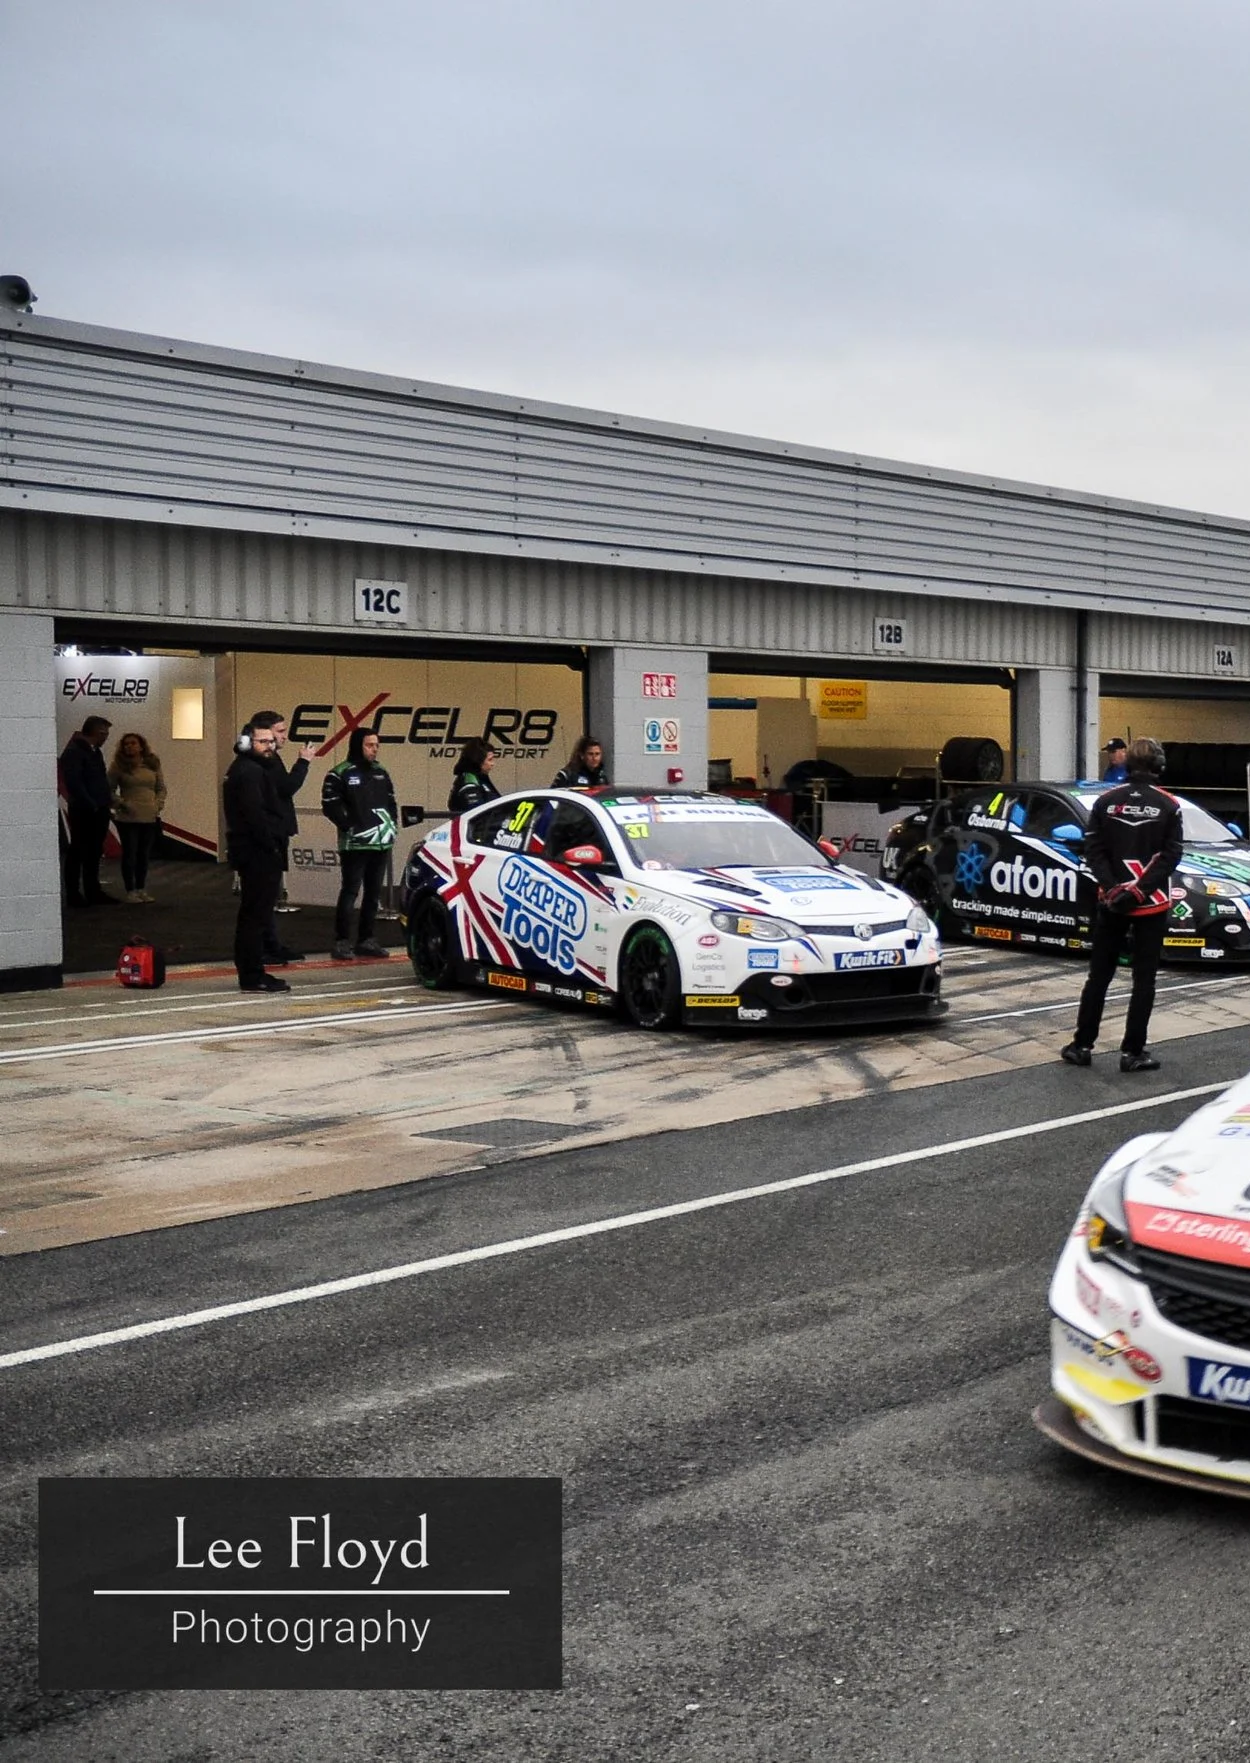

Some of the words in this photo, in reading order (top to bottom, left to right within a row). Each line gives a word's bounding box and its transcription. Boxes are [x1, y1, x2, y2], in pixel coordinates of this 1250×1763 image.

[362, 587, 401, 614] 12C
[879, 624, 902, 643] 12B
[1216, 651, 1234, 667] 12A
[63, 673, 149, 701] EXCELR8
[824, 687, 861, 697] CAUTION
[287, 692, 557, 757] EXCELR8
[429, 747, 548, 759] MOTSPORT
[988, 792, 1004, 816] 4
[508, 801, 534, 832] 37
[968, 812, 1007, 831] Osborne
[493, 829, 523, 849] Smith
[624, 823, 650, 839] 37
[990, 854, 1077, 902] atom
[505, 863, 578, 930] DRAPER
[952, 898, 992, 916] tracking
[993, 905, 1020, 919] made
[1021, 907, 1076, 926] simple.com
[503, 895, 575, 970] Tools
[490, 973, 525, 990] AUTOCAR
[738, 1006, 767, 1021] forge
